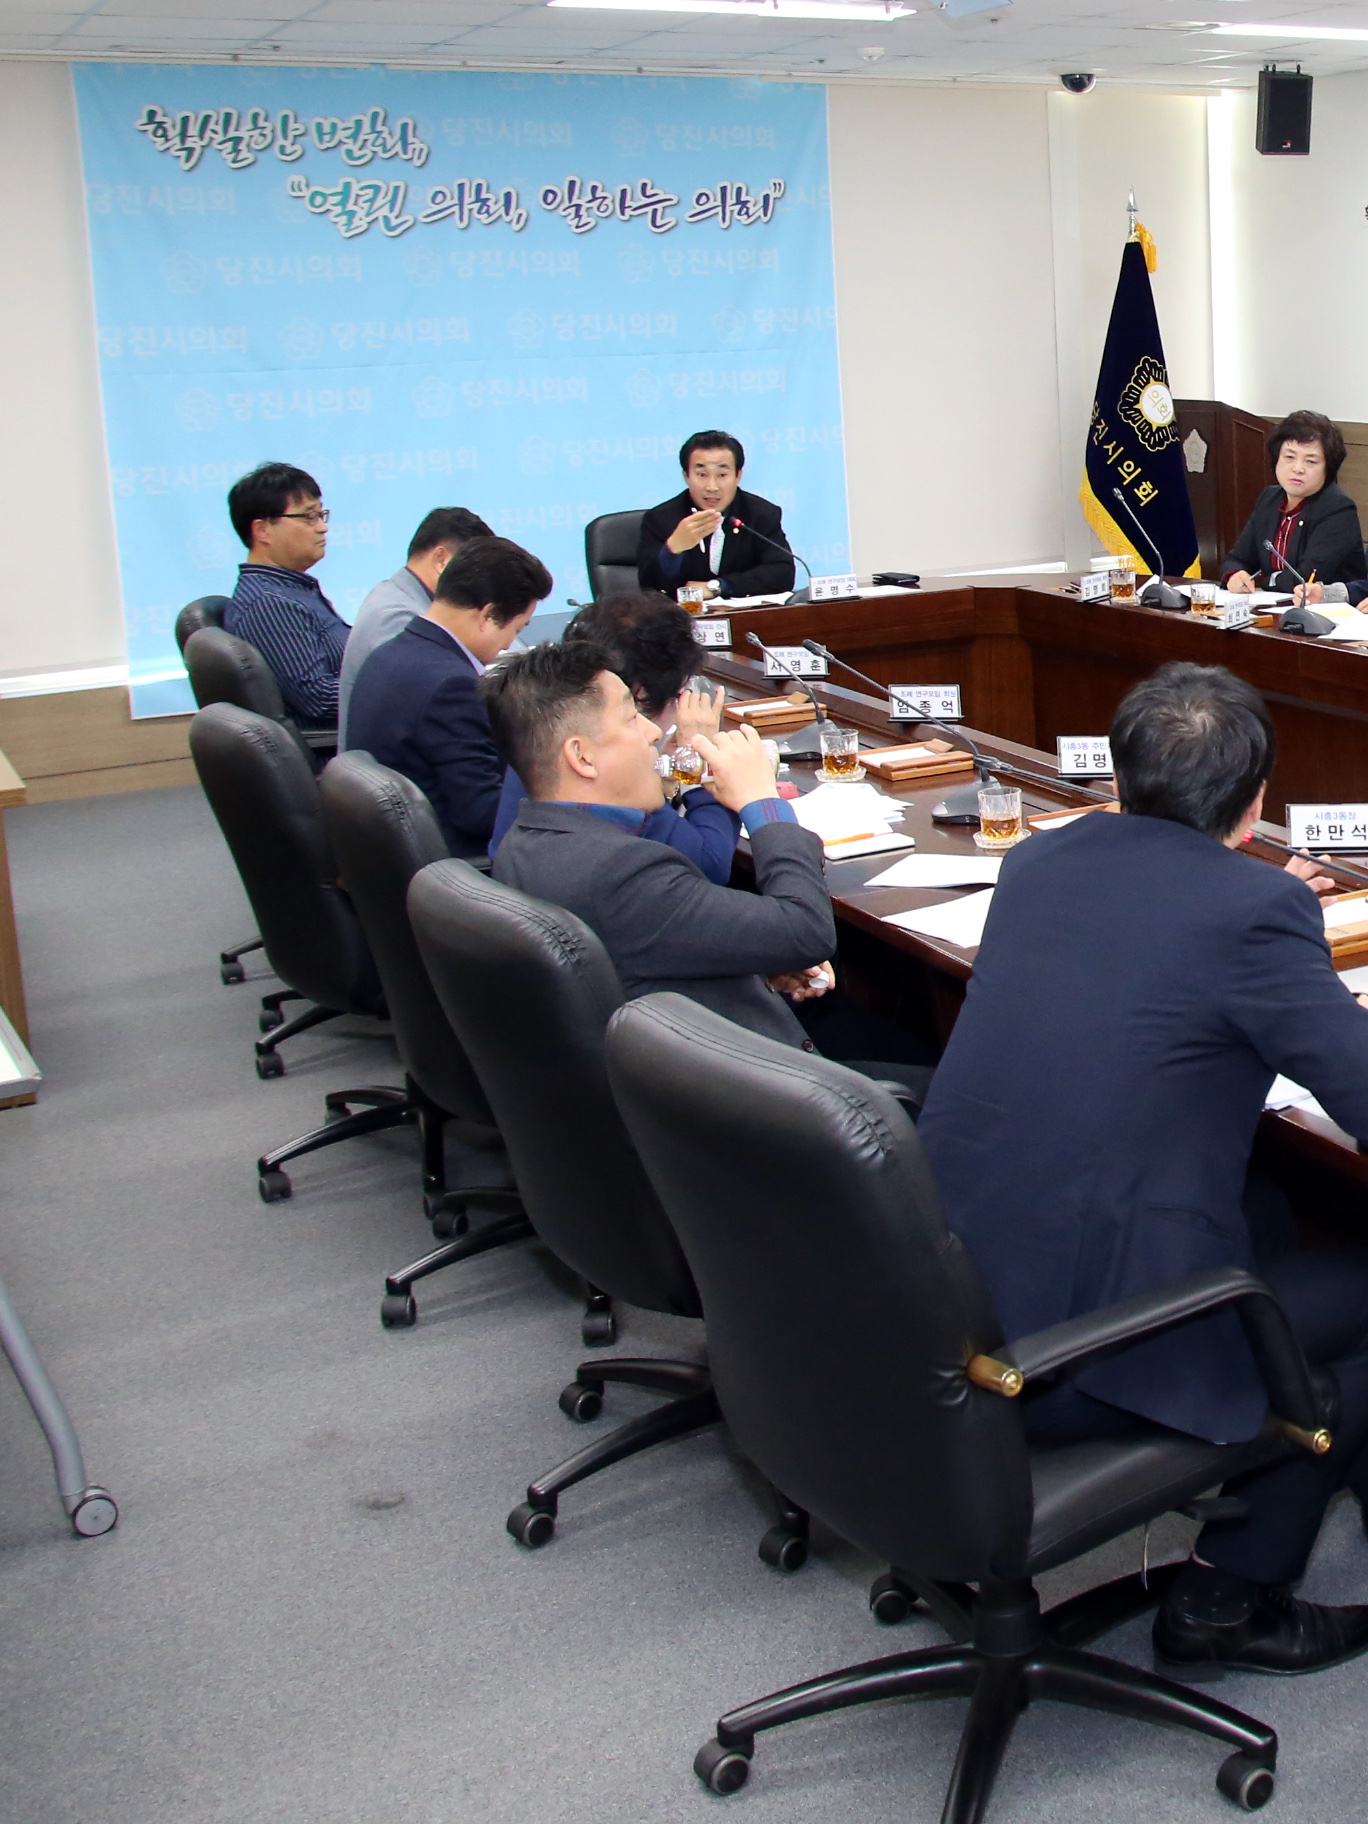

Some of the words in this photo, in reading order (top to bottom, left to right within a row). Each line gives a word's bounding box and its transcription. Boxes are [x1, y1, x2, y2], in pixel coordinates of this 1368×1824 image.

[135, 104, 306, 170] 확실한
[441, 117, 574, 148] 당진시의회
[655, 122, 776, 152] 당진시의회
[538, 175, 680, 233] 일하는
[215, 253, 363, 286] 당진시의회
[449, 248, 581, 279] 당진시의회
[661, 246, 781, 277] 당진시의회
[331, 315, 471, 351] 당진시의회
[551, 311, 678, 342] 당진시의회
[460, 375, 589, 408] 당진시의회
[667, 367, 787, 399] 당진시의회
[226, 387, 372, 423] 당진시의회
[340, 447, 480, 483] 당진시의회
[1073, 753, 1106, 768] 김명
[1305, 824, 1367, 841] 한만석
